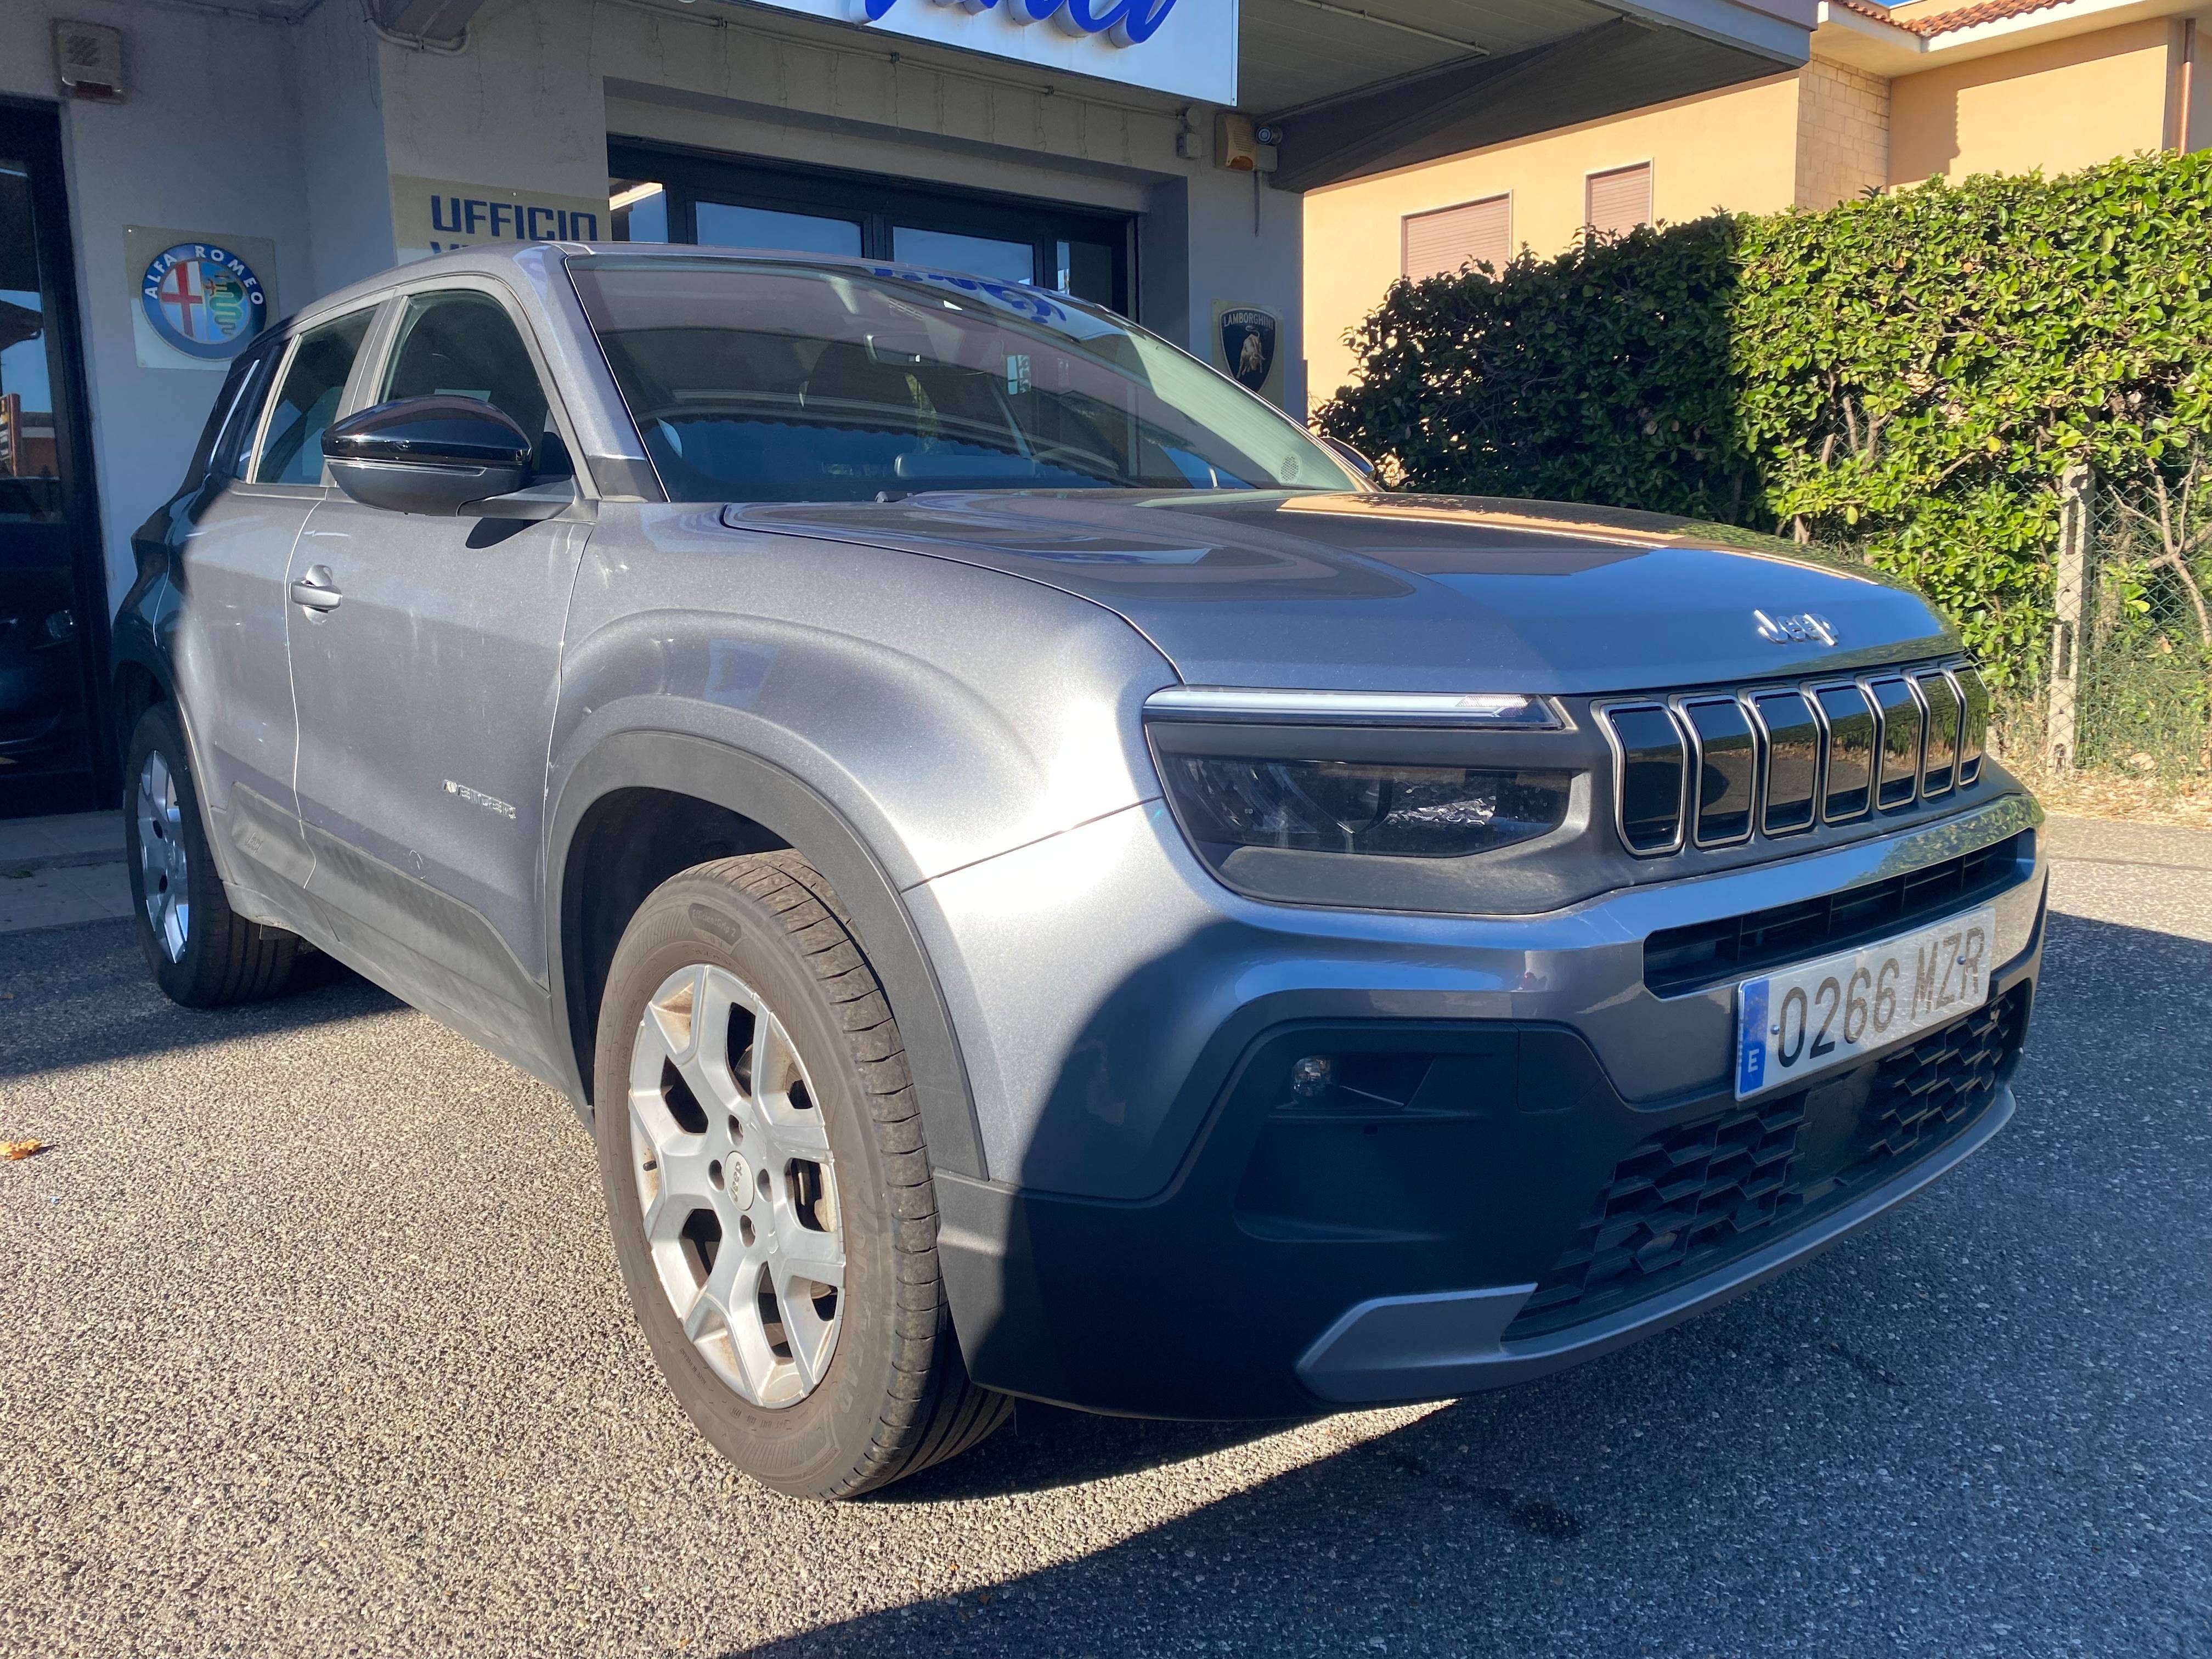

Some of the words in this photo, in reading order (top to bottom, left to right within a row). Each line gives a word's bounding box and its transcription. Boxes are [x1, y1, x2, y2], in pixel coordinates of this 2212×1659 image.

[431, 195, 597, 241] UFFICIO
[144, 253, 177, 299] ALFA
[194, 245, 264, 304] ROMEO
[1223, 312, 1274, 330] LAMBORGHINI
[1753, 608, 1839, 646] Jeep
[731, 927, 736, 938] 2
[1778, 957, 1900, 1068] 0266
[1911, 926, 1985, 1020] MZR
[1748, 1047, 1758, 1073] E
[730, 1161, 742, 1202] Jeep
